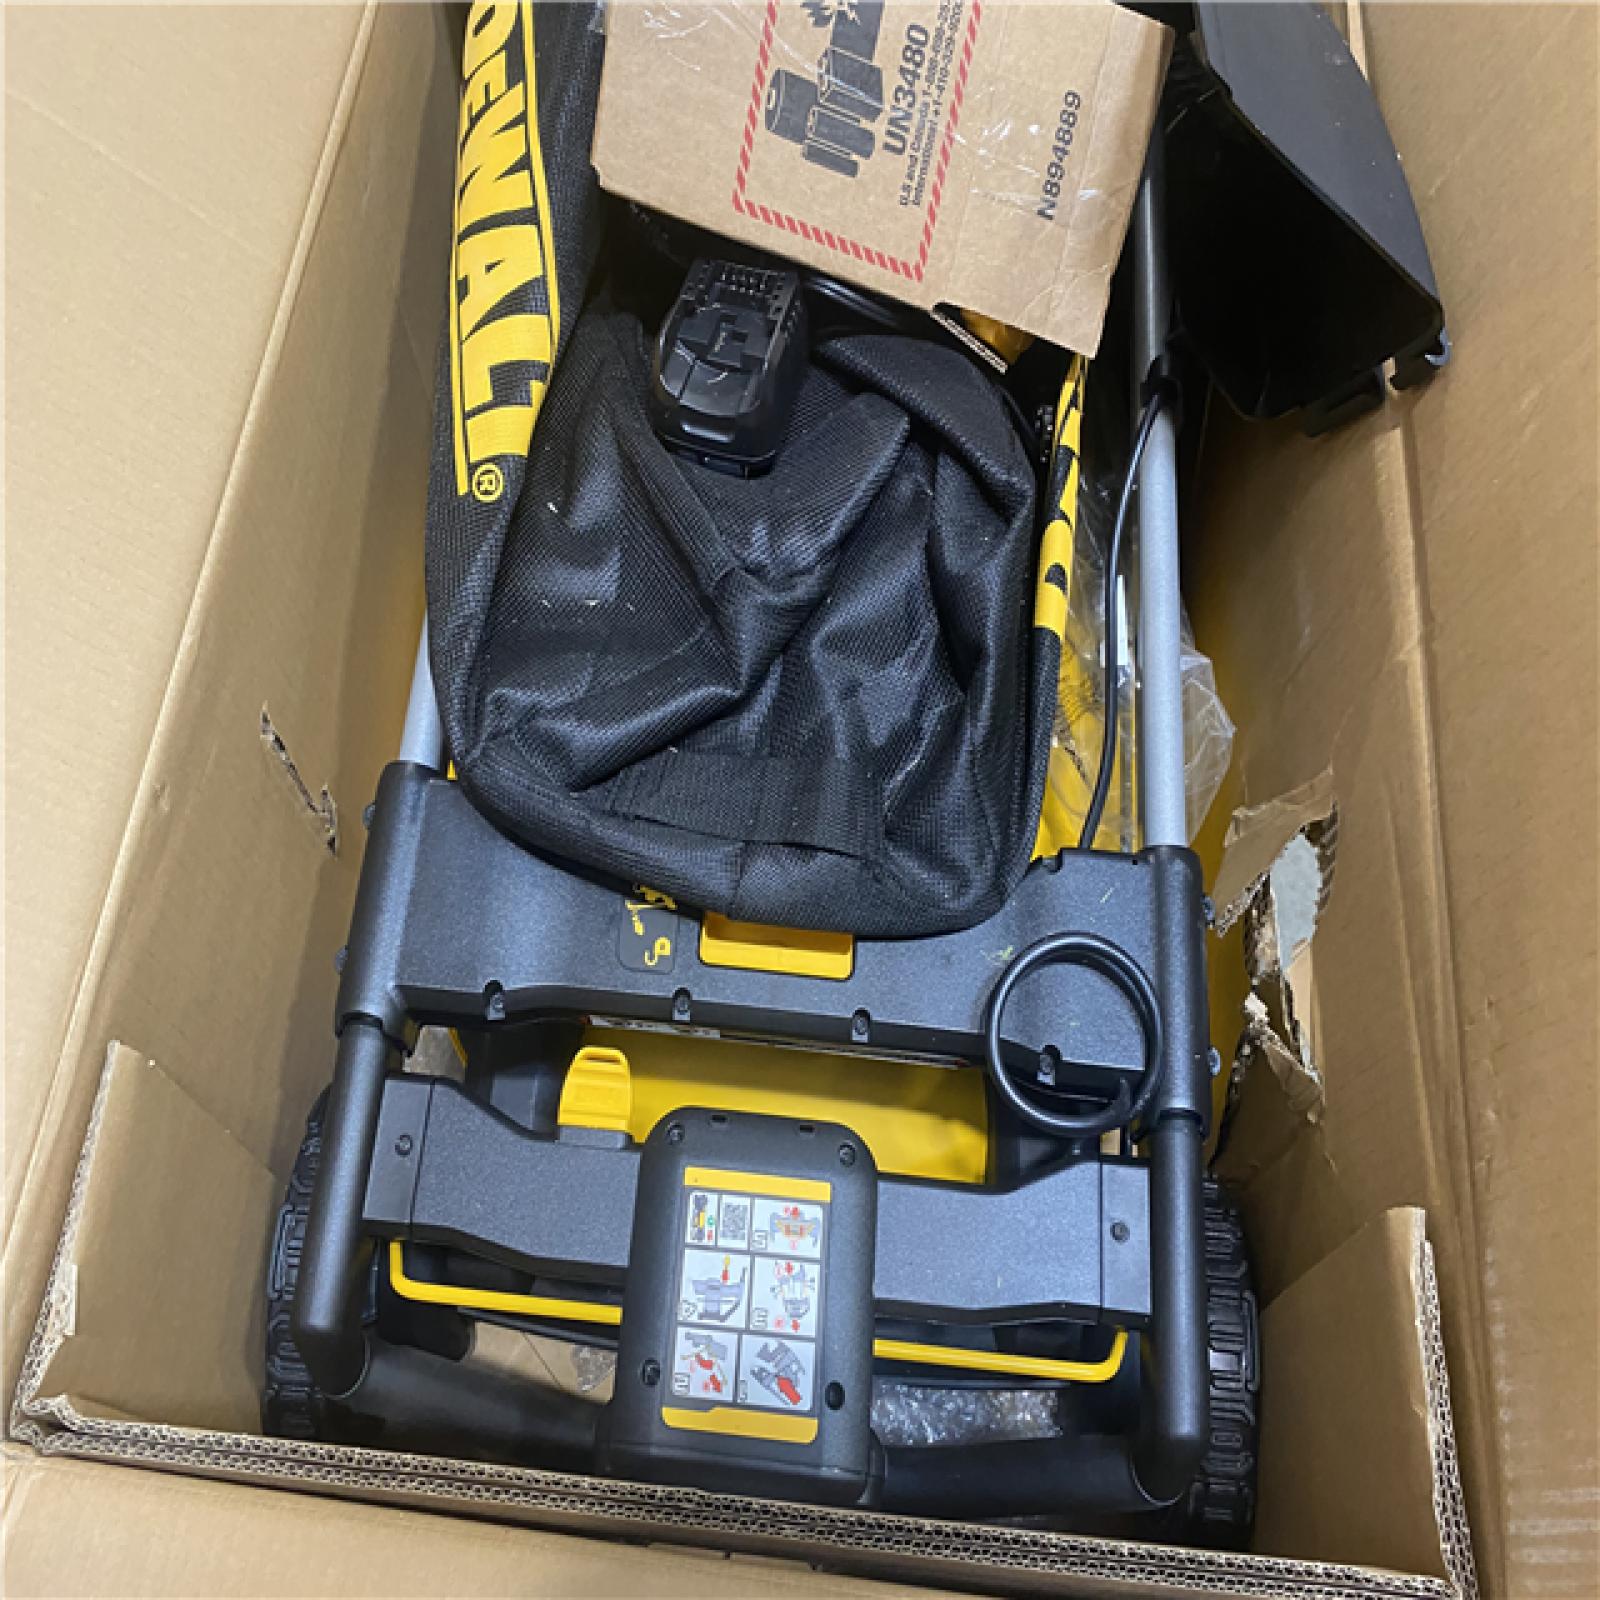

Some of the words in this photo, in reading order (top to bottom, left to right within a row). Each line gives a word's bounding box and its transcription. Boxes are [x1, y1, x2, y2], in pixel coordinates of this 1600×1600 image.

[882, 23, 928, 155] UN3480
[912, 119, 939, 206] International
[1036, 90, 1081, 220] N894889
